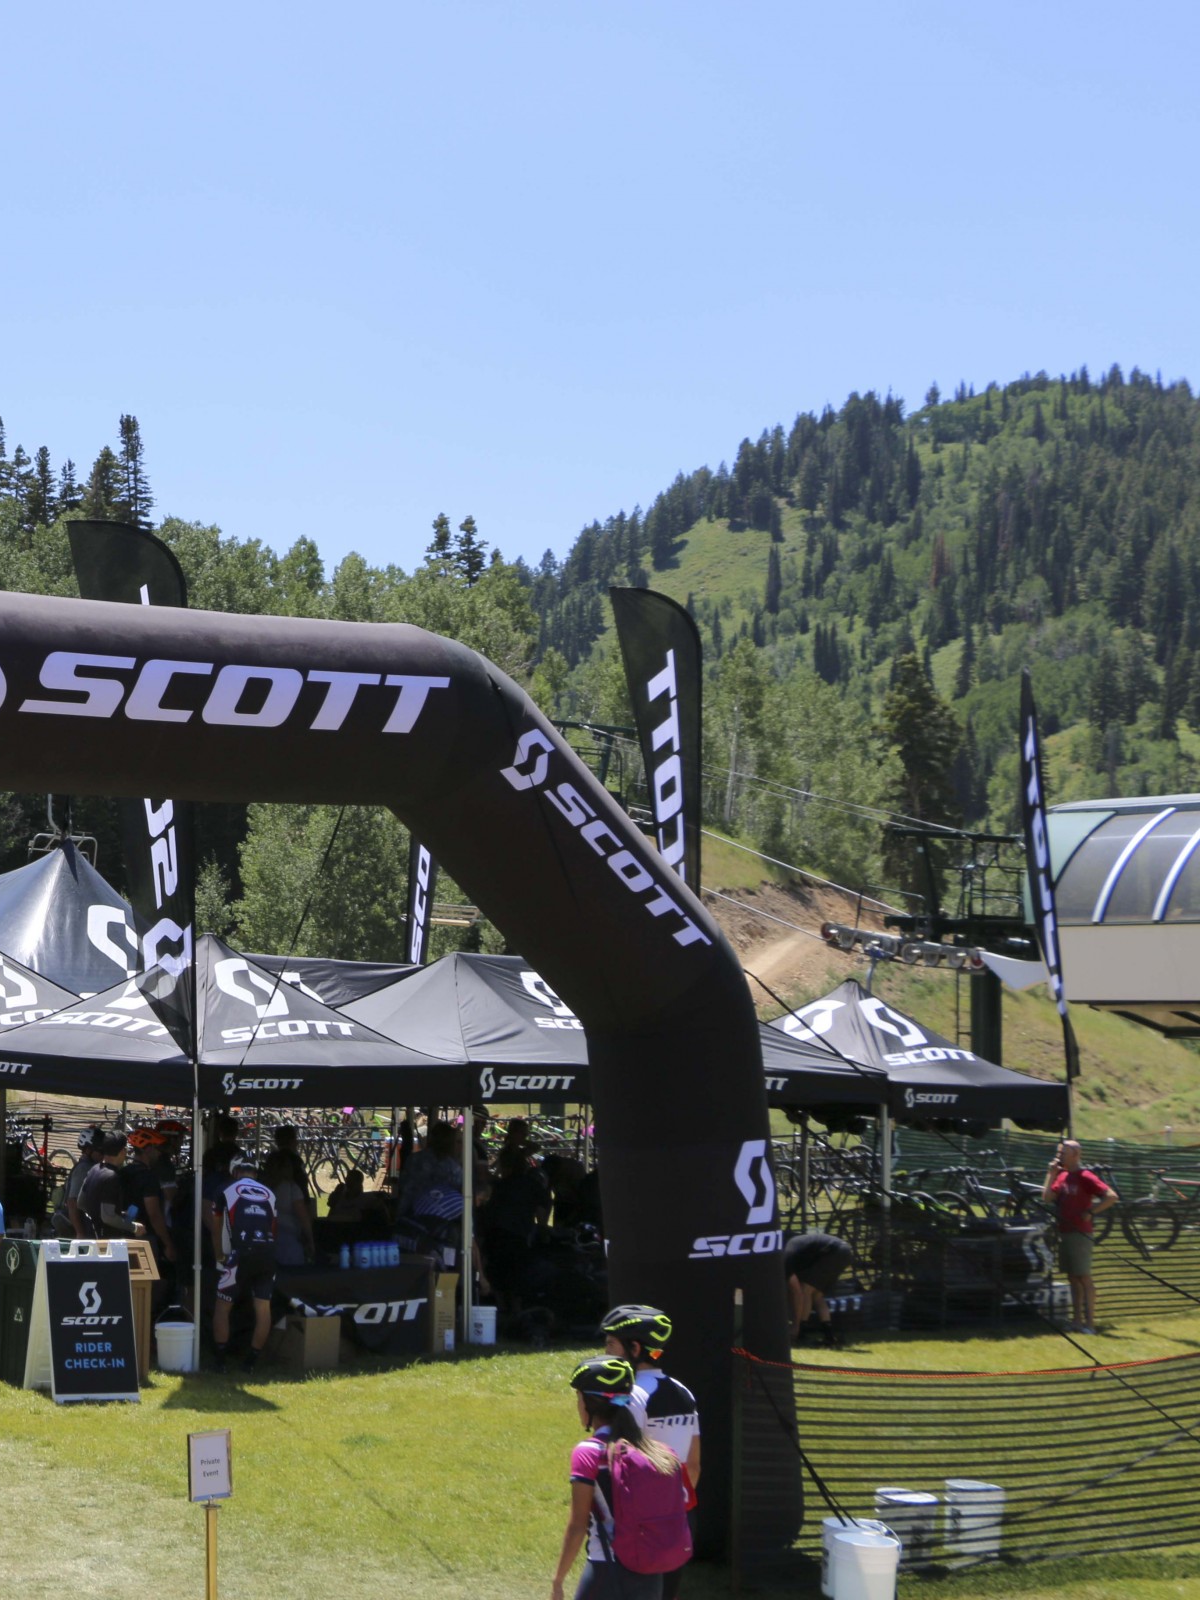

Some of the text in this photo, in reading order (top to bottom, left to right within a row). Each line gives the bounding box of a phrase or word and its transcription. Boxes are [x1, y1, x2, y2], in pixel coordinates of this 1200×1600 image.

[19, 650, 451, 734] SCOTT
[544, 782, 712, 947] SCOTT
[411, 844, 431, 966] SCO
[39, 1011, 170, 1037] SCOTT
[220, 1019, 354, 1044] SCOTT
[882, 1046, 976, 1066] SCOTT
[237, 1078, 304, 1089] SCOTT
[497, 1075, 576, 1090] SCOTT
[915, 1093, 959, 1104] SCOTT
[688, 1230, 783, 1259] SCO
[60, 1315, 123, 1326] SCOTT
[75, 1342, 113, 1353] RIDER
[64, 1357, 126, 1369] CHECK-IN
[200, 1458, 220, 1466] Private
